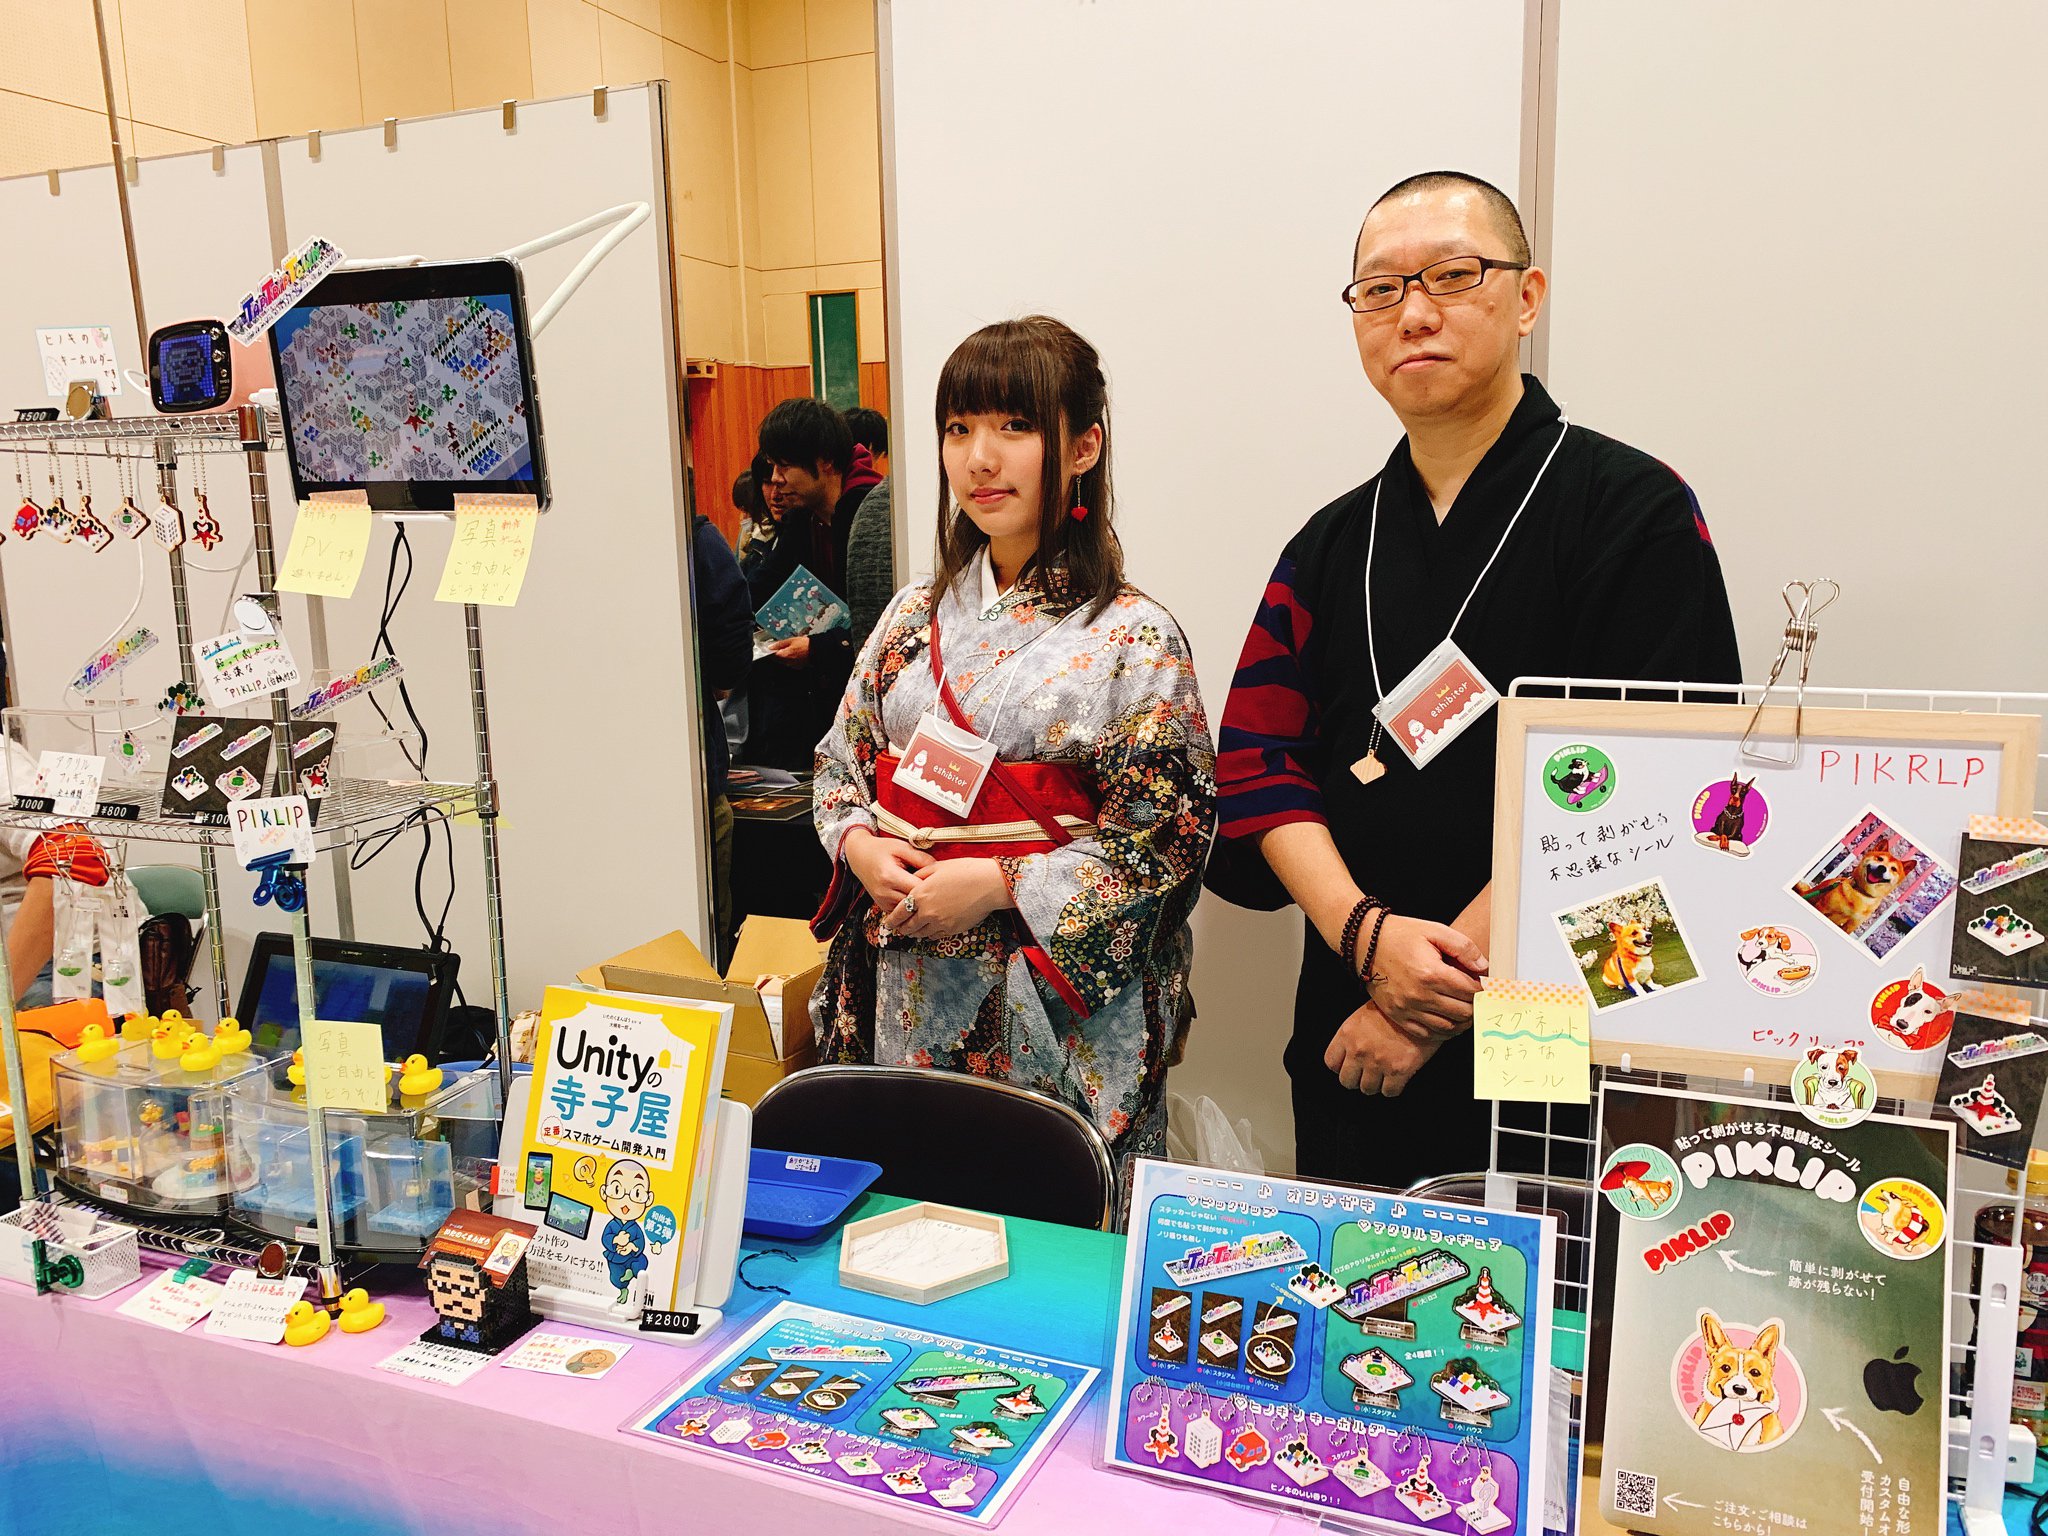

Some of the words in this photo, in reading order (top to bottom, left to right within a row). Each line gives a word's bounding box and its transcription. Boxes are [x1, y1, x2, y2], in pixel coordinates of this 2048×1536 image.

[20, 411, 47, 421] ¥500
[300, 535, 332, 557] PV
[461, 519, 497, 548] 写真
[1430, 681, 1468, 718] exhibitor
[1553, 746, 1588, 762] PIKLIP
[933, 765, 967, 787] exhibitor
[1820, 750, 1985, 788] PIKRLP
[13, 799, 44, 810] ¥1000
[101, 805, 127, 817] ¥800
[237, 805, 304, 831] PIKLIP
[1550, 834, 1675, 881] 不思議なシール
[1751, 977, 1781, 994] PIKLIP
[1875, 983, 1901, 1009] PIKLIP
[1488, 1010, 1578, 1038] マグネット
[318, 1030, 351, 1057] 写真
[1483, 1044, 1554, 1061] のような
[1502, 1070, 1564, 1088] シール
[551, 1075, 671, 1139] 寺子屋
[1818, 1114, 1848, 1123] PIKLIP
[543, 1126, 560, 1137] 定番
[563, 1128, 667, 1161] スマホゲーム開発入門
[1675, 1122, 1862, 1174] 貼って剥がせる不思議なシール
[1681, 1140, 1857, 1203] PIKLIP
[1200, 1196, 1278, 1218] ピックリップ
[1287, 1187, 1377, 1214] オシナガキ
[1901, 1183, 1936, 1209] PIKLIP
[645, 1218, 674, 1240] 第2弾
[651, 1211, 672, 1226] 和尚本
[532, 1234, 569, 1249] ット作の
[1374, 1221, 1502, 1251] アクリルフィギュア
[1643, 1213, 1732, 1272] PIKLIP
[1789, 1259, 1887, 1286] 簡単に剥がせて
[1788, 1275, 1875, 1300] 跡が残らない!
[646, 1313, 690, 1327] ¥2800
[1681, 1346, 1702, 1404] PIKLIP
[1713, 1500, 1808, 1531] ご注文・ご相談は
[1895, 1477, 1911, 1534] 自由な形
